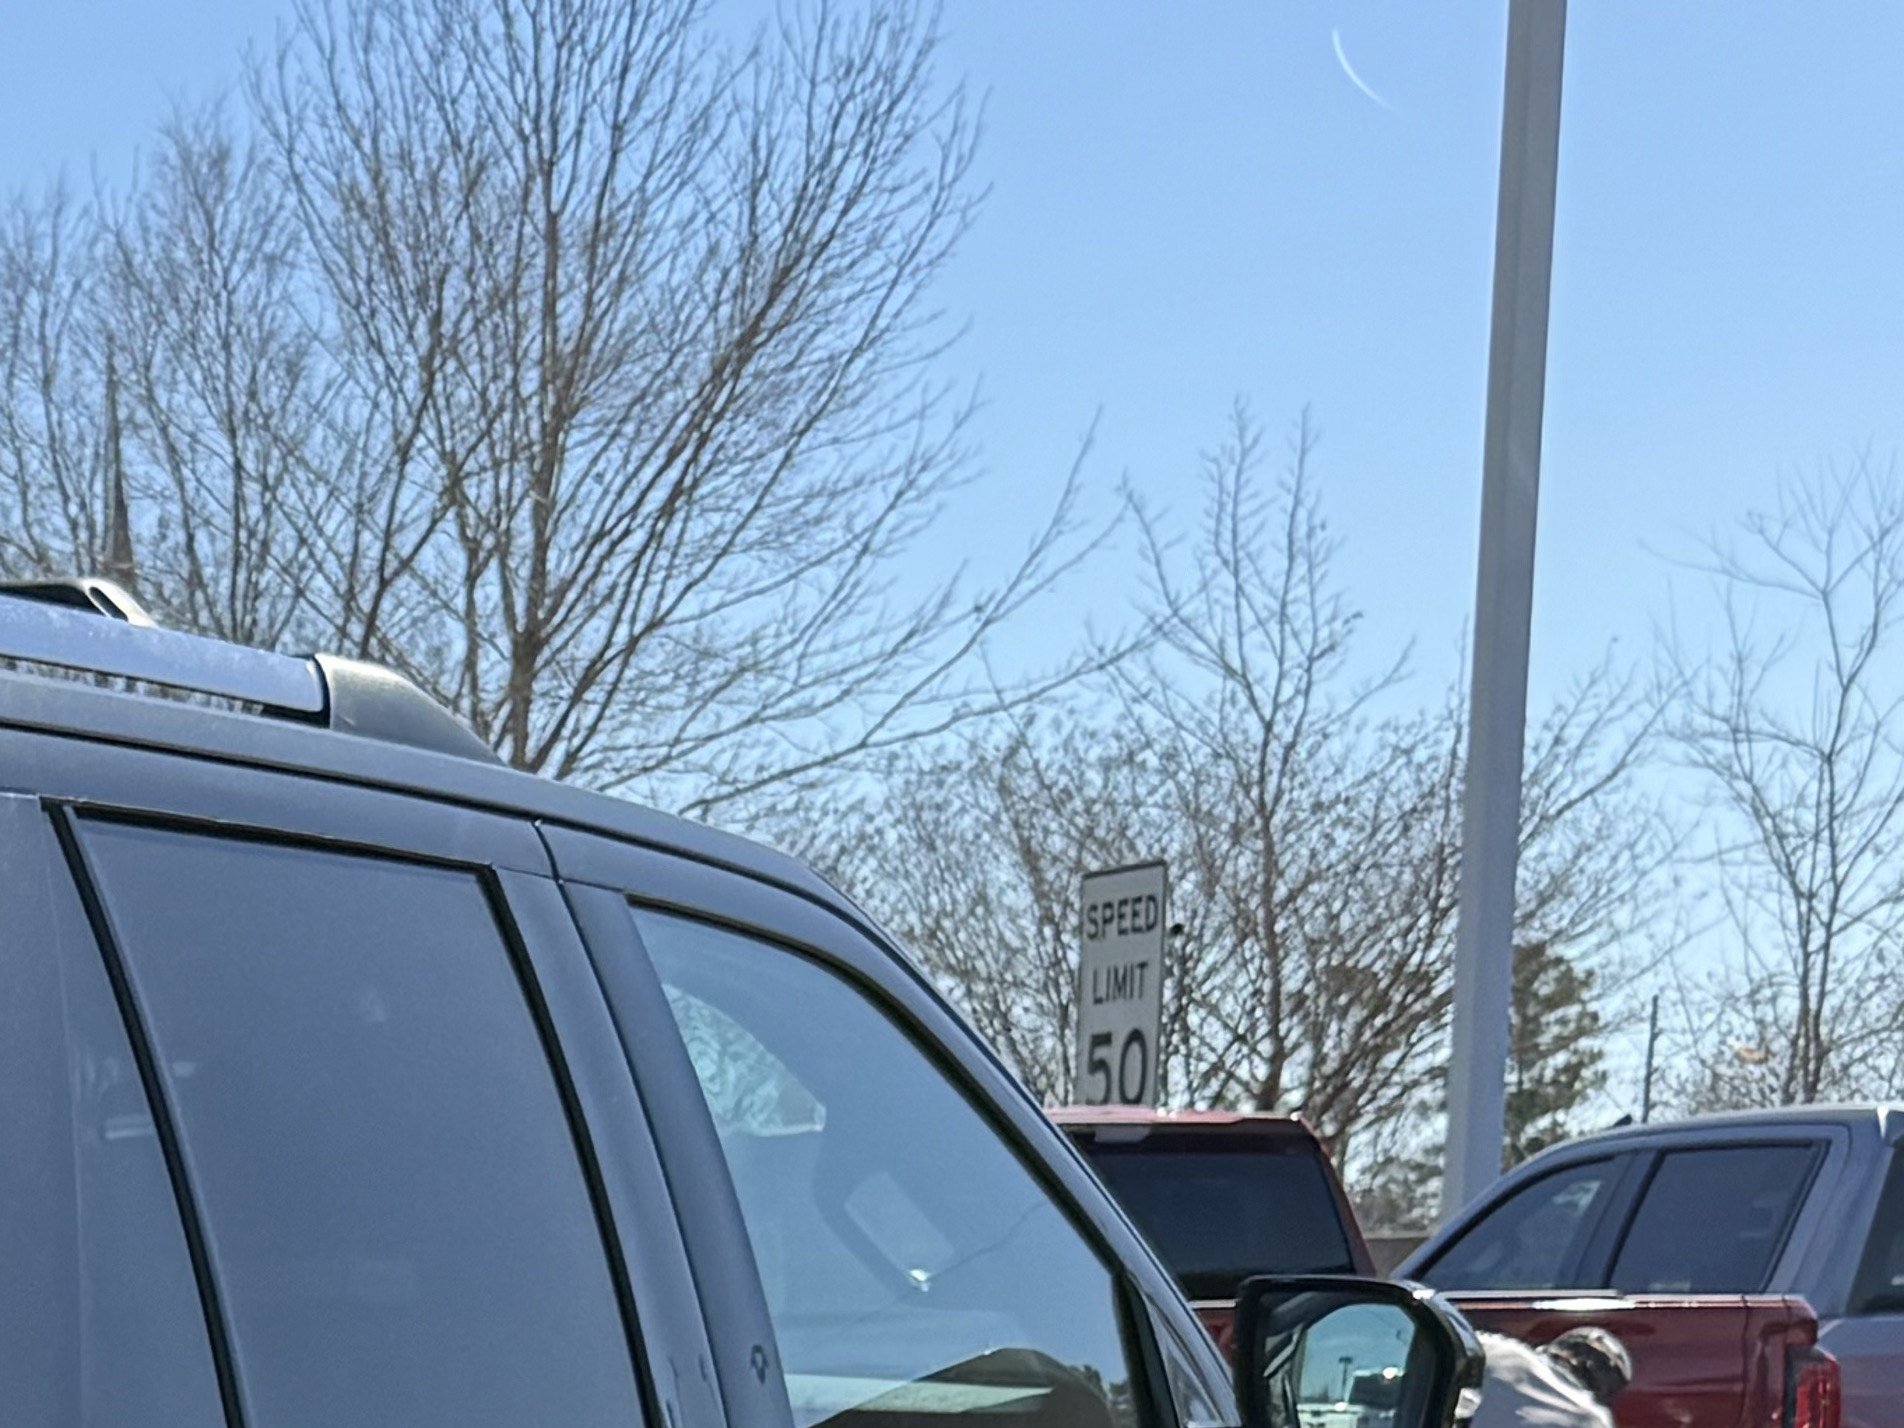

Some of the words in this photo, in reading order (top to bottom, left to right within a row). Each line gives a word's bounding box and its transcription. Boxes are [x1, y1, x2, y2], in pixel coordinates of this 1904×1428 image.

[1086, 895, 1159, 939] SPEED
[1093, 960, 1148, 1004] LIMIT
[1085, 1028, 1148, 1105] 50
